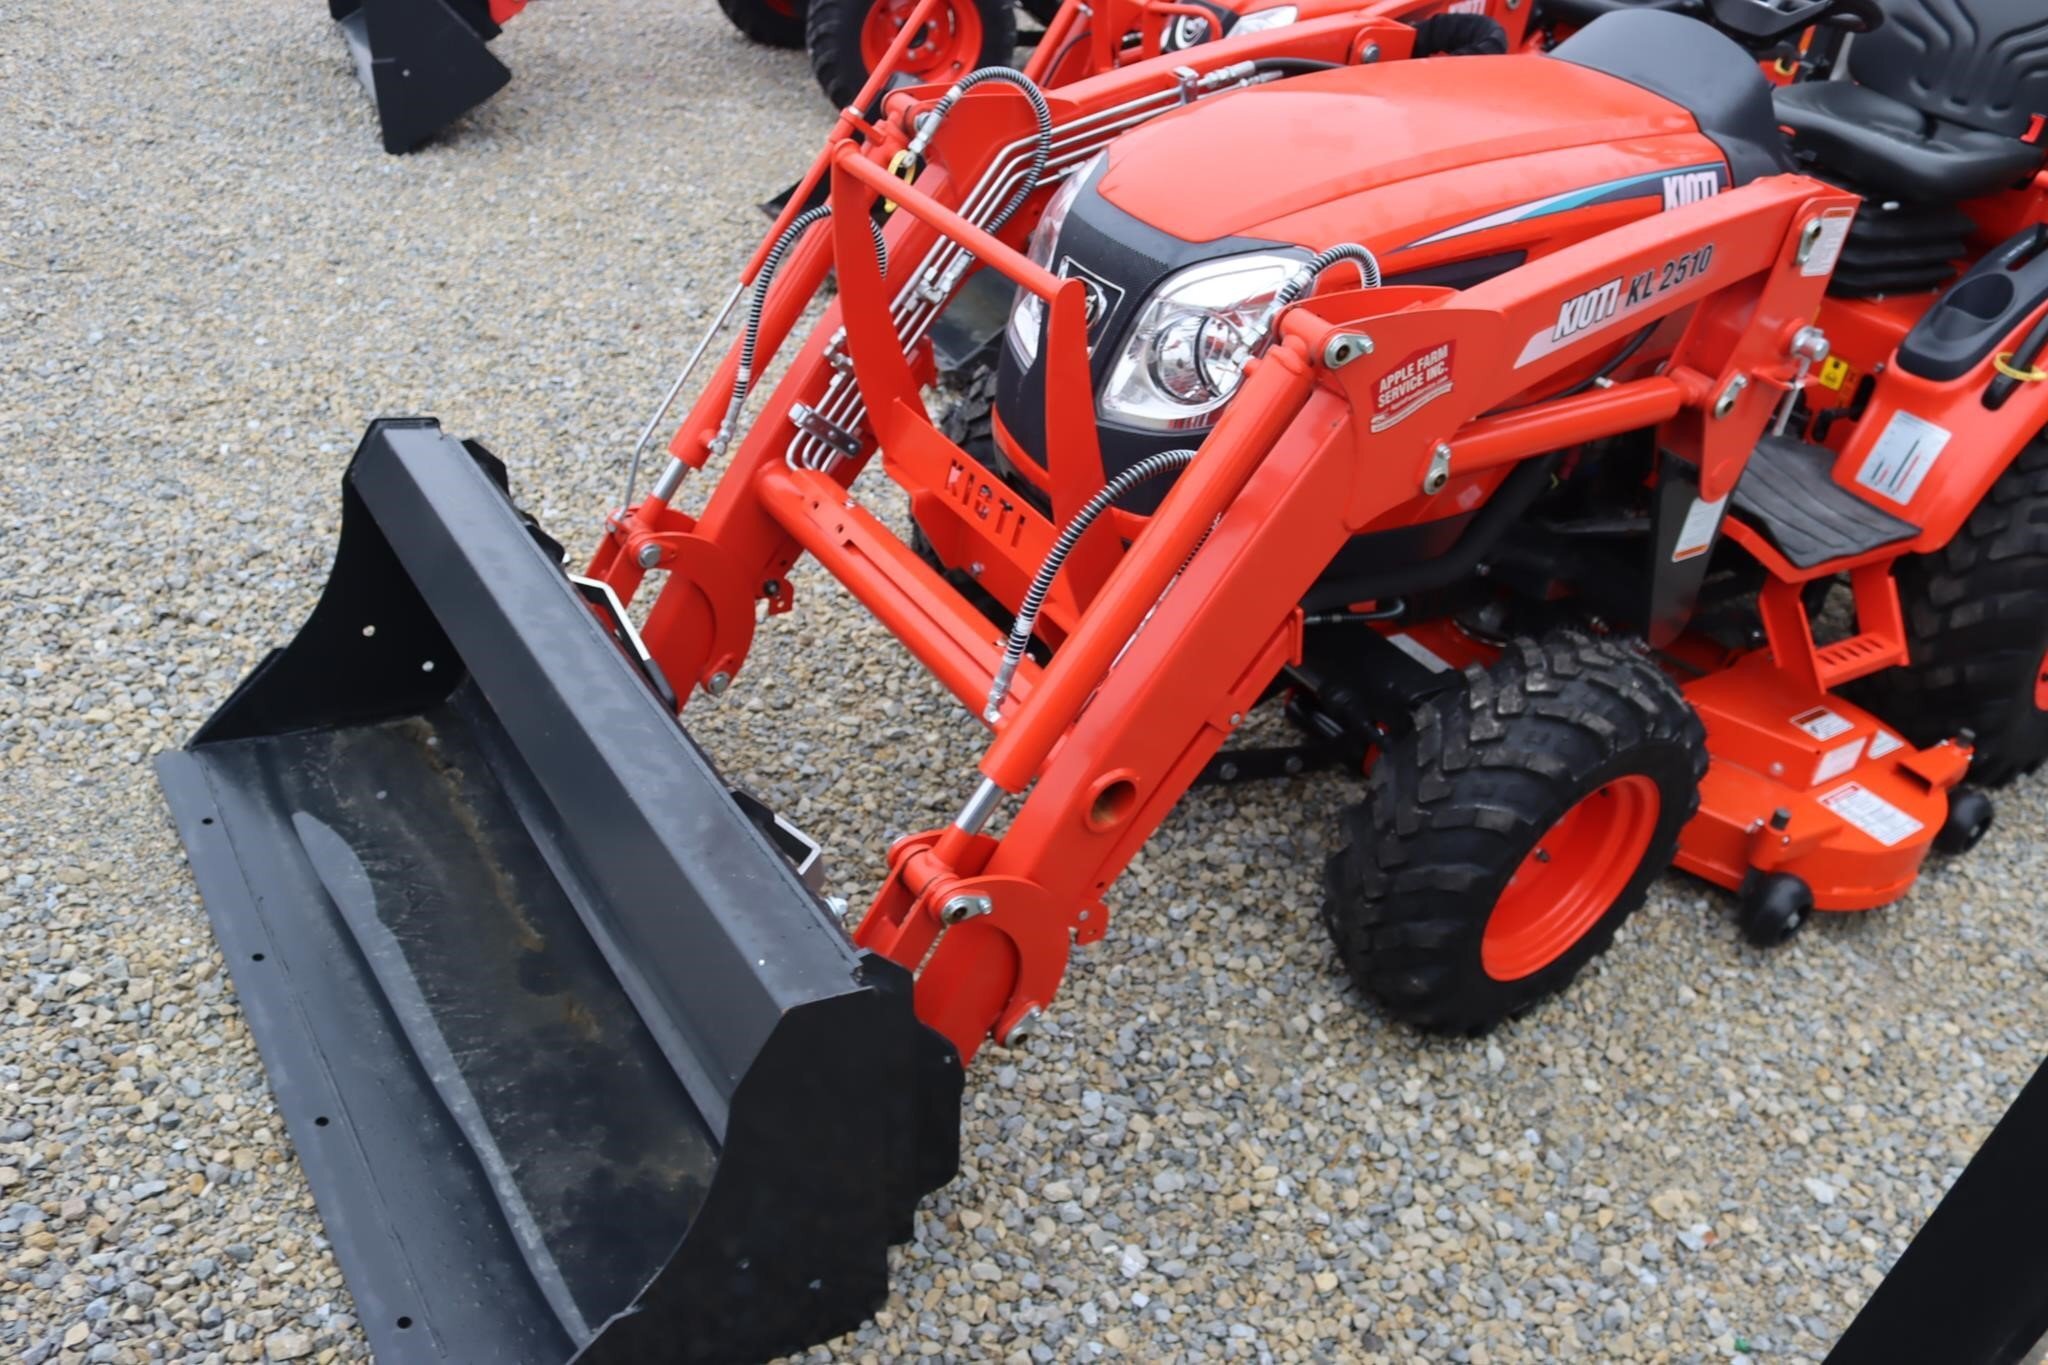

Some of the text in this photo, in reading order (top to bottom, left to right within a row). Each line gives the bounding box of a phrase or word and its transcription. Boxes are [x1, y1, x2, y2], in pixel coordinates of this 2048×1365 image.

[1663, 170, 1718, 212] KIOTI
[1552, 243, 1714, 342] KIOTI KL 2510
[1377, 372, 1425, 408] SERVICE
[1426, 361, 1449, 382] INC.
[1378, 363, 1415, 393] APPLE
[1417, 344, 1449, 373] FARM
[944, 458, 1026, 547] KIOTI
